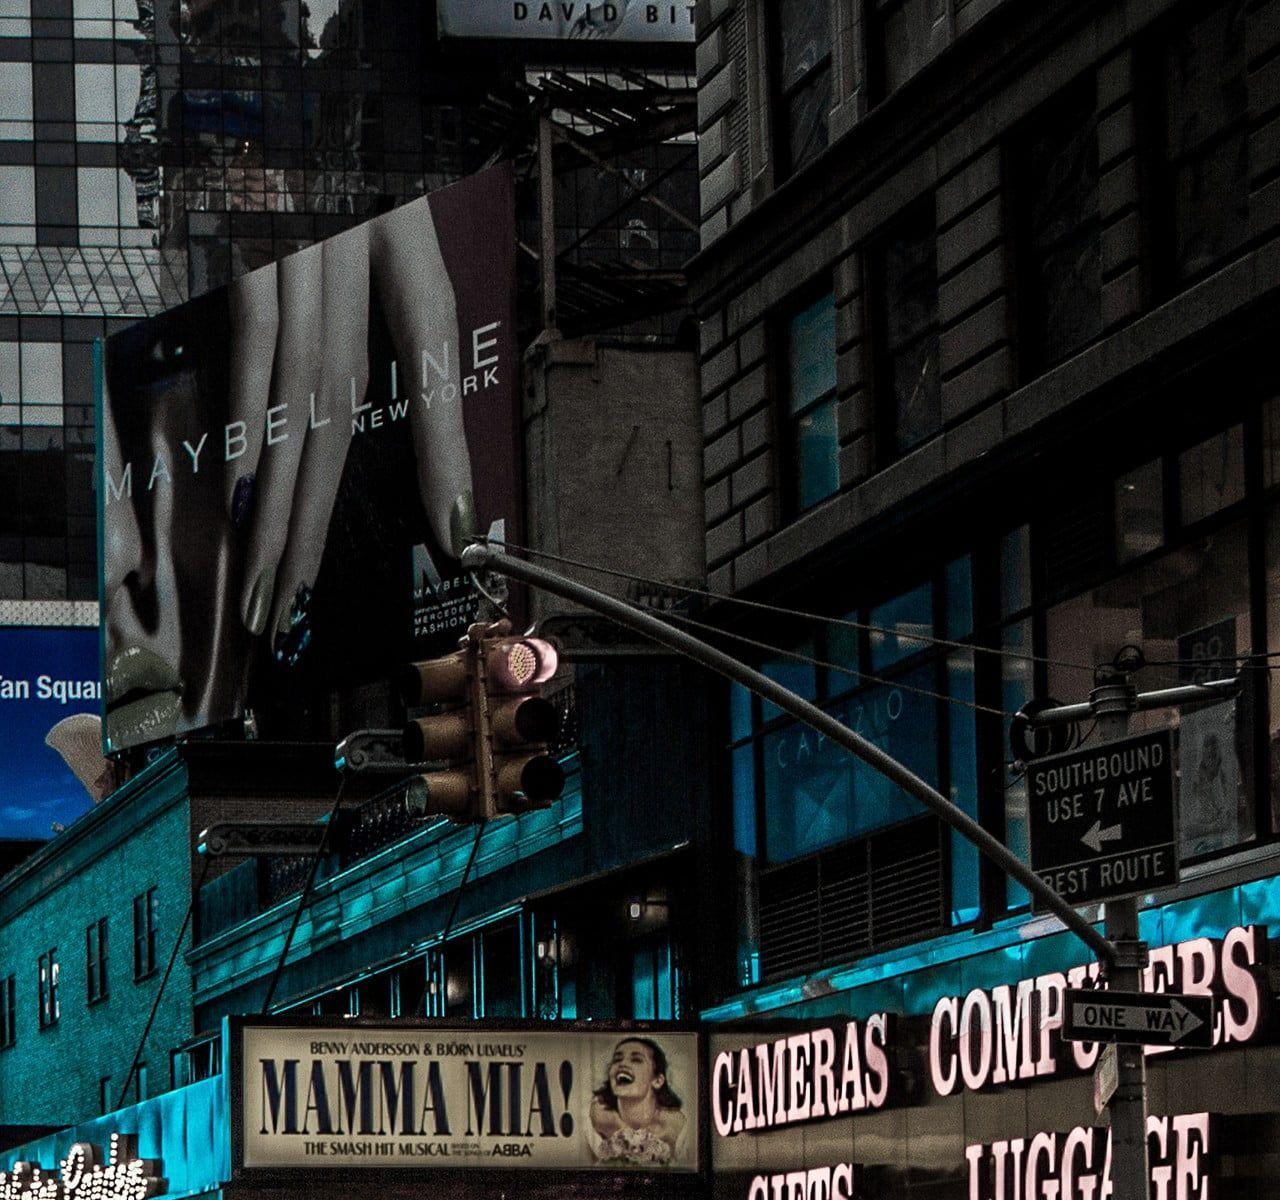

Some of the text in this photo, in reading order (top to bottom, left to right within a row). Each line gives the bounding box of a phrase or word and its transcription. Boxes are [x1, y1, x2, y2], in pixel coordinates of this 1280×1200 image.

[513, 2, 617, 22] DAVID
[104, 321, 501, 506] MAYBELLINE
[352, 365, 500, 436] NEW YORK
[1036, 743, 1164, 796] SOUTHBOUND
[1047, 776, 1153, 824] USE 7 AVE
[1100, 852, 1165, 888] ROUTE
[929, 925, 1258, 1097] COMPUERS
[1084, 1006, 1189, 1031] ONE WAY
[310, 1041, 349, 1055] BENNY
[351, 1042, 420, 1056] ANDERSSON
[424, 1043, 433, 1056] &
[436, 1040, 474, 1057] BJÖRN
[259, 1059, 574, 1138] MAMMA MIA!
[712, 1012, 888, 1137] CAMERAS
[305, 1142, 450, 1157] THE SMASH HIT MUSICAL
[492, 1143, 531, 1158] ABBA
